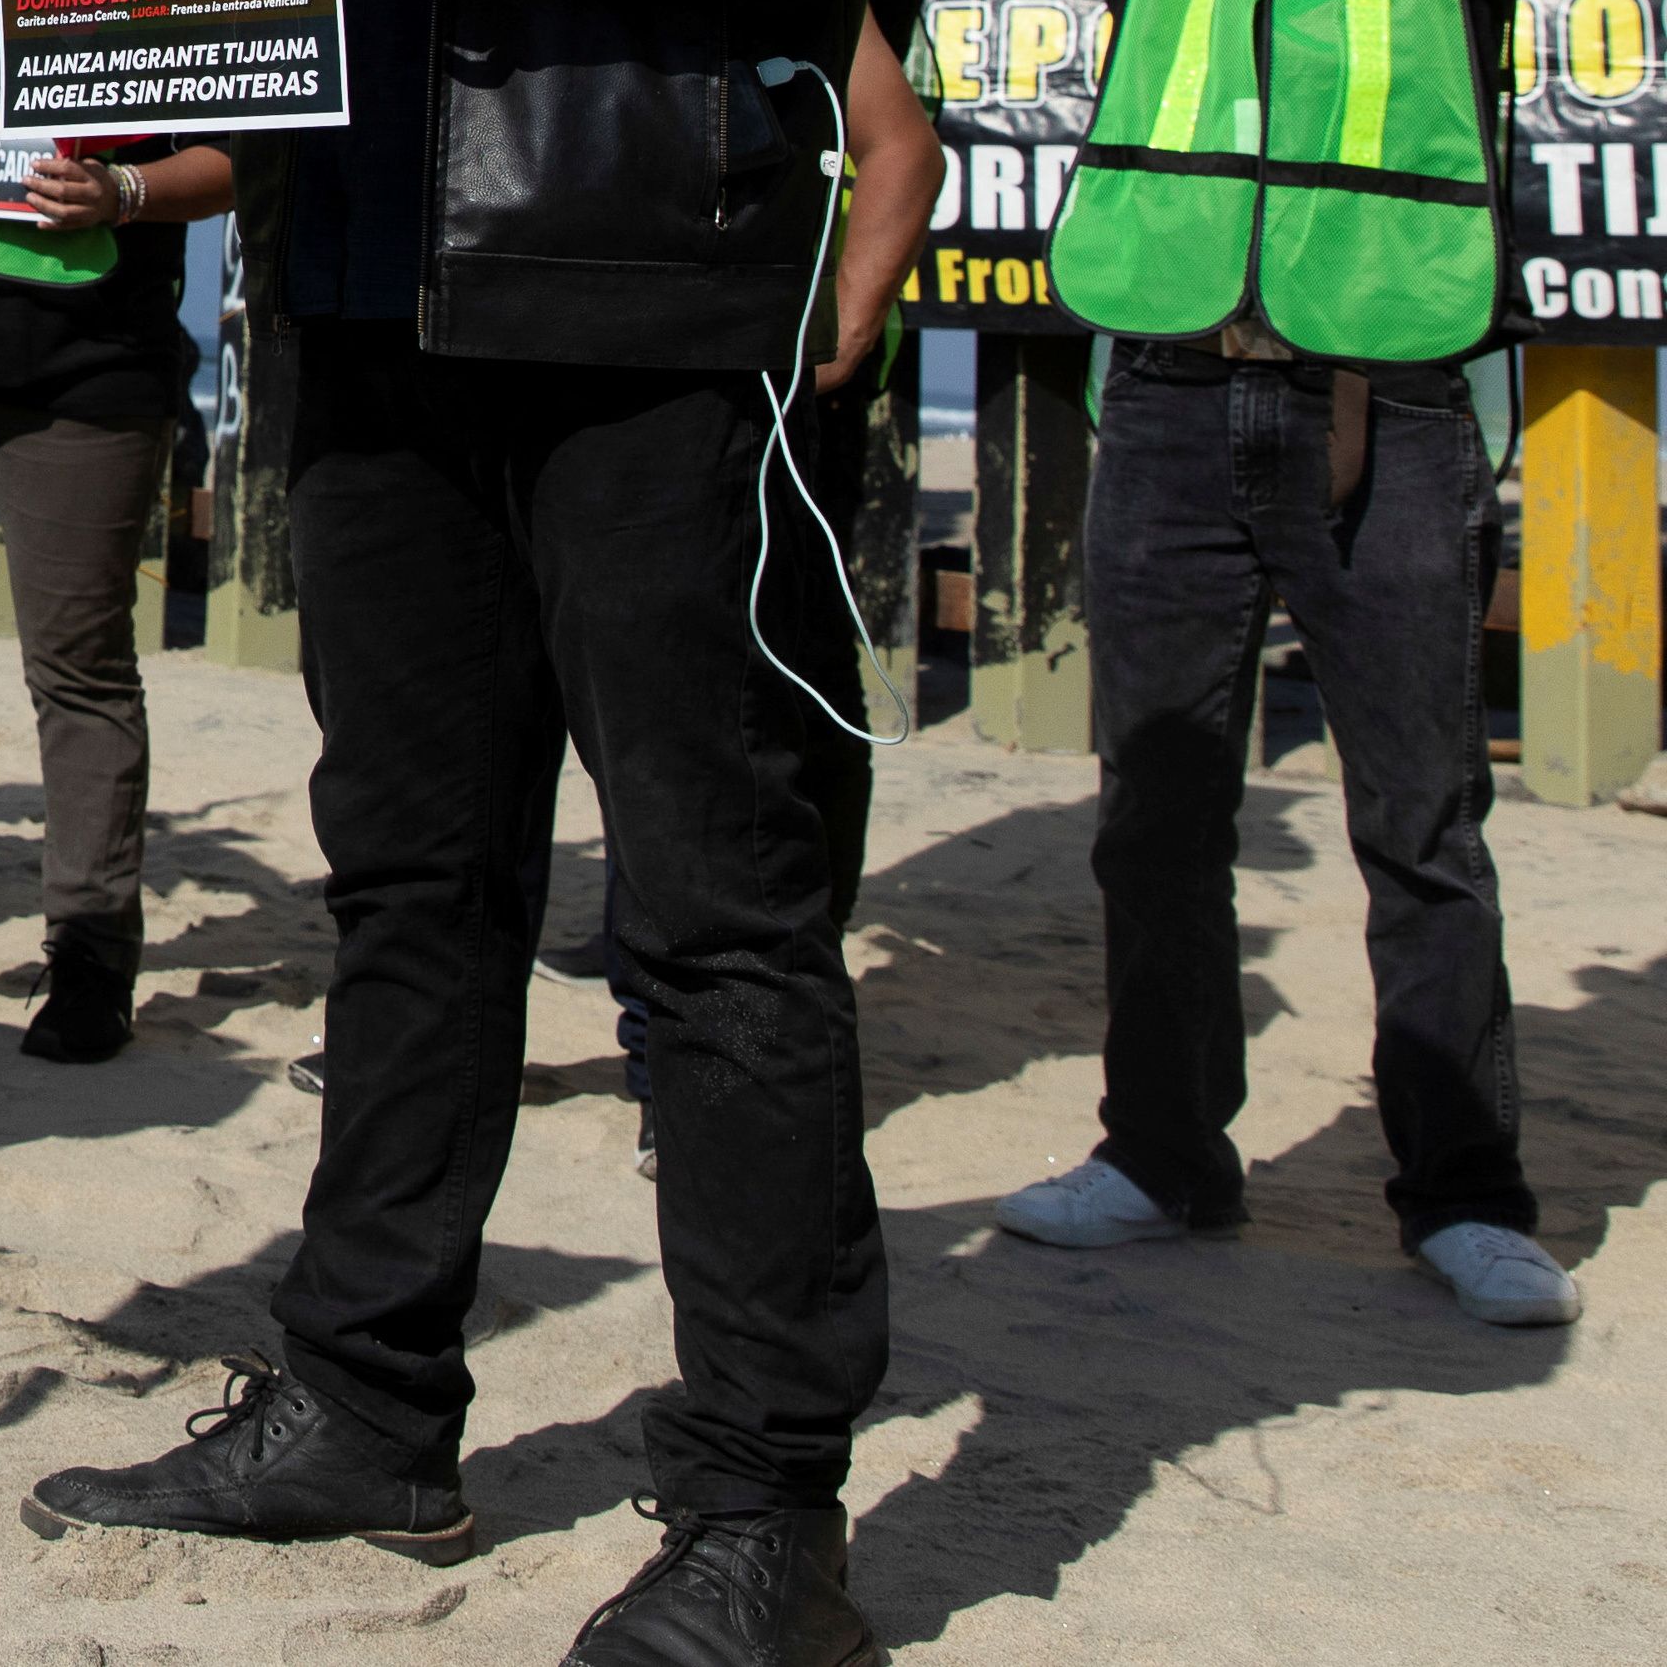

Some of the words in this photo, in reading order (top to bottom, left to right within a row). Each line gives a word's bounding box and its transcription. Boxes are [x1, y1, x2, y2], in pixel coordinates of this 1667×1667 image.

[17, 15, 46, 27] Garita
[47, 14, 58, 25] de
[60, 13, 68, 24] la
[69, 12, 93, 23] Zona
[94, 9, 130, 22] Centro,
[131, 5, 170, 19] LUGAR:
[170, 3, 202, 16] Frente
[204, 5, 211, 13] a
[212, 1, 221, 12] la
[222, 0, 262, 11] entrada
[17, 52, 104, 77] ALIANZA
[107, 43, 220, 72] MIGRANTE
[223, 36, 319, 64] TIJUANA
[13, 82, 119, 111] ANGELES
[121, 79, 162, 105] SIN
[166, 70, 319, 102] FRONTERAS
